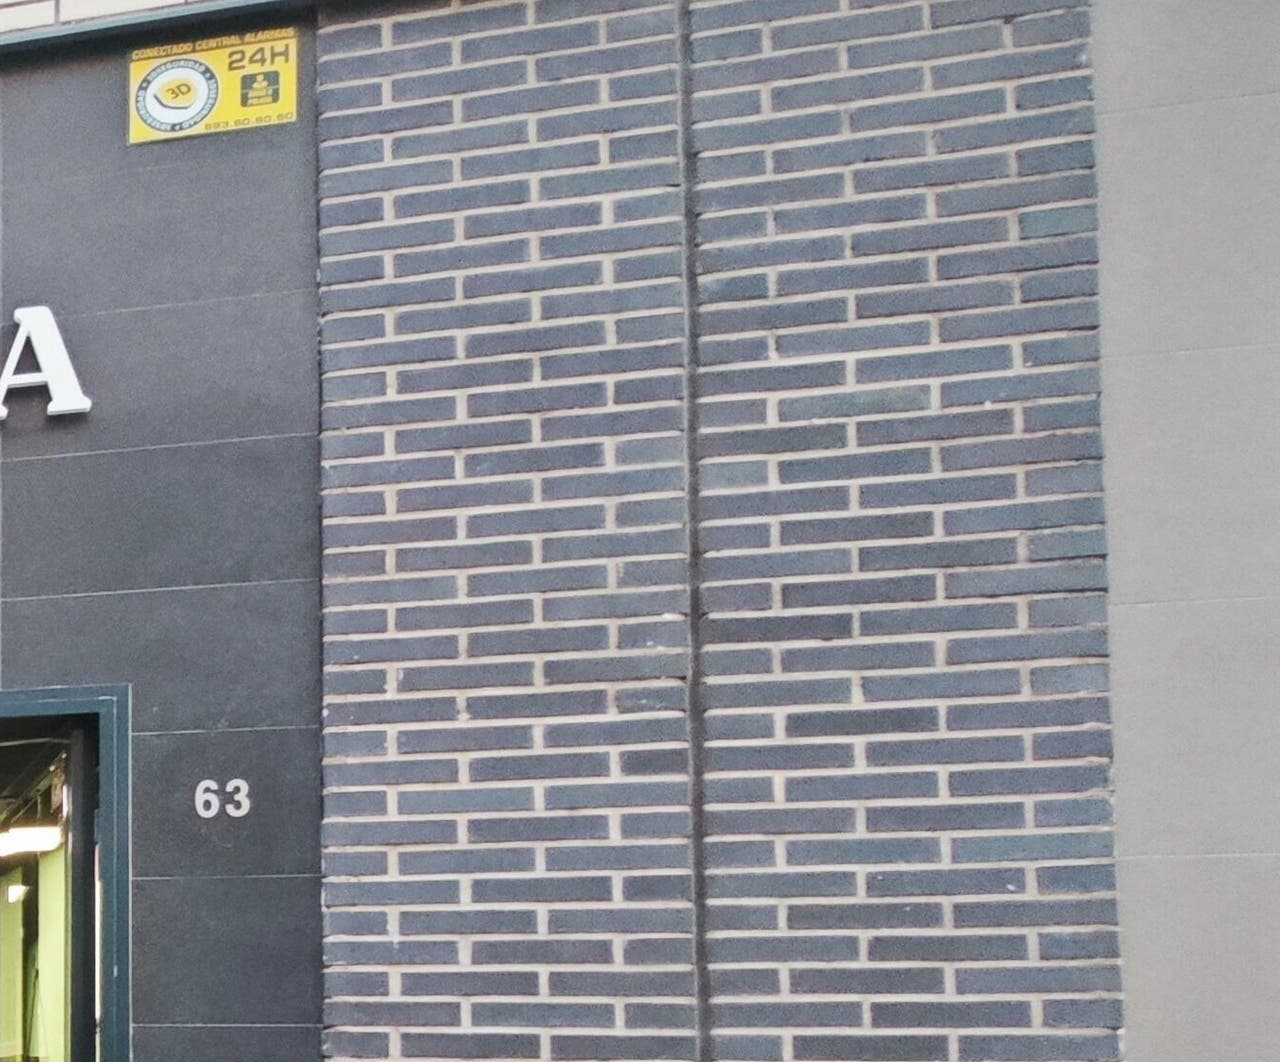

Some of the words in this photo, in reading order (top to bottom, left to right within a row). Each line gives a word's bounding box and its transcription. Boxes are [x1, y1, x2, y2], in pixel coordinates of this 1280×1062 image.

[228, 43, 290, 71] 24H
[166, 83, 191, 100] 3D
[194, 778, 250, 818] 63
